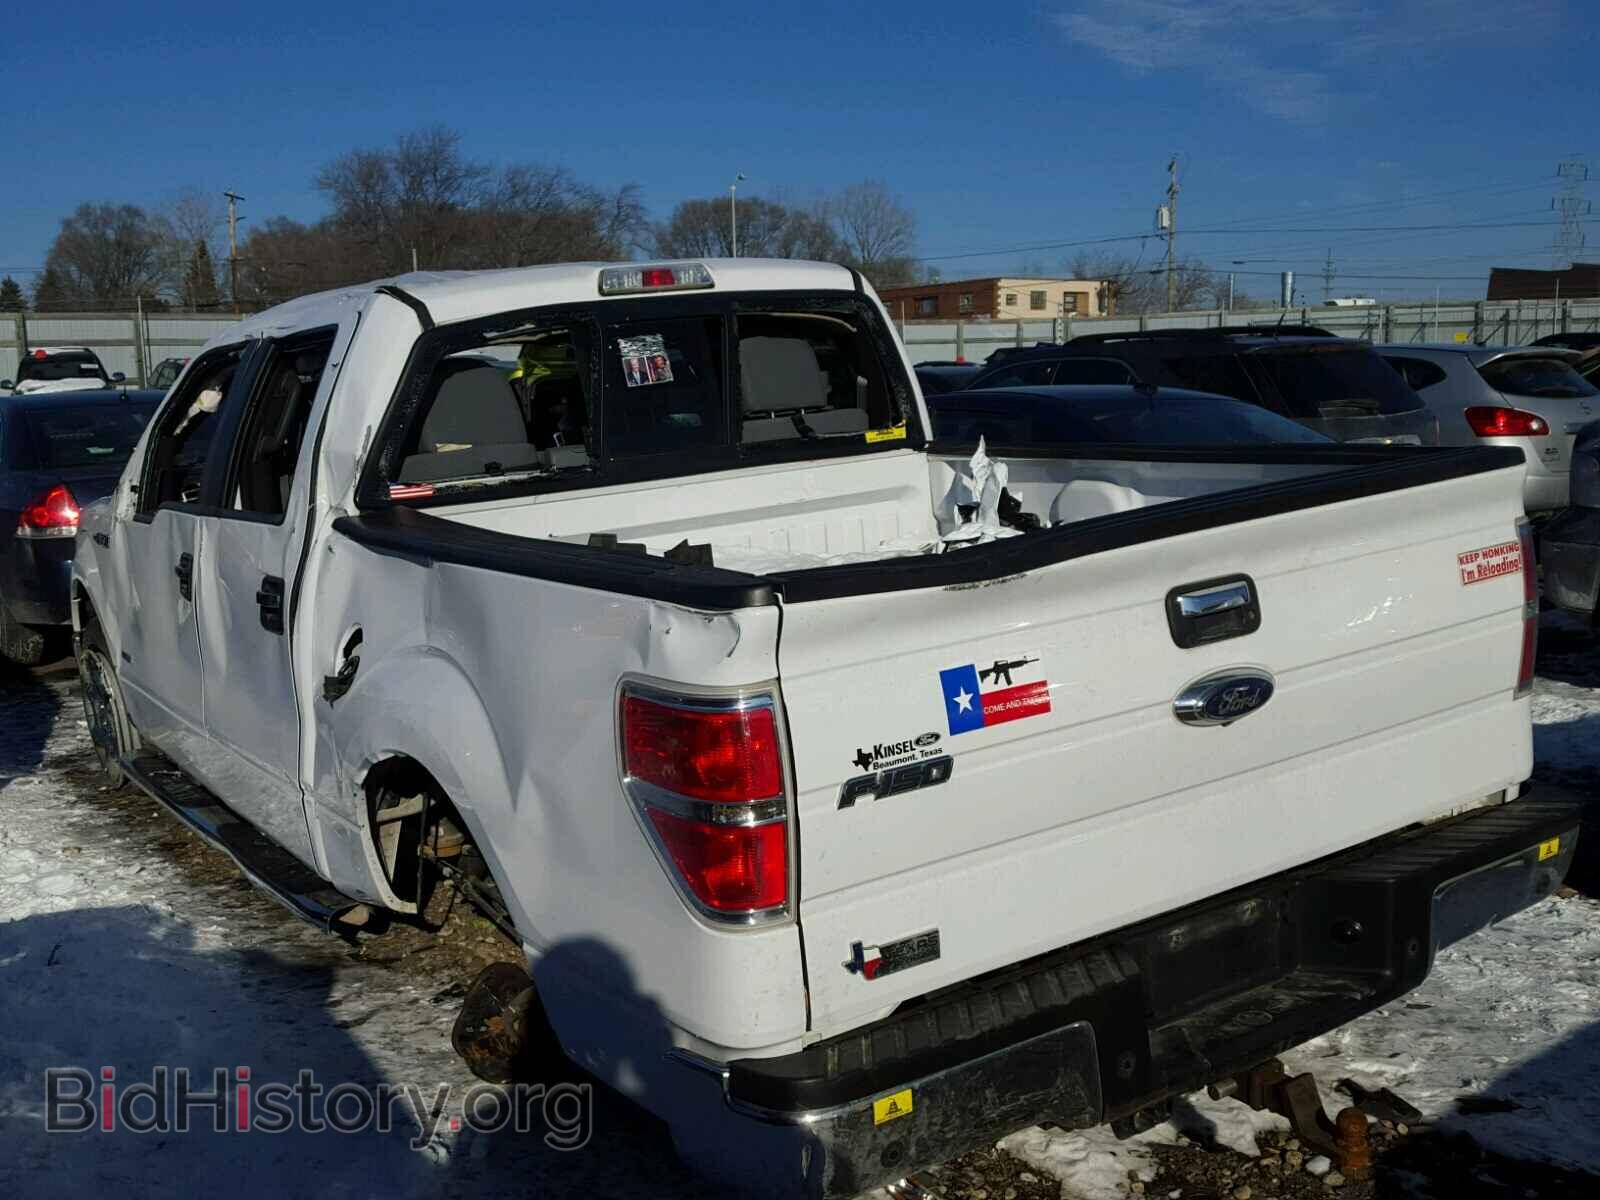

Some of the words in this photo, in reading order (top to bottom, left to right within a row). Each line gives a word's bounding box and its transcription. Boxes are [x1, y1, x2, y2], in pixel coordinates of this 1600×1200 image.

[1459, 553, 1480, 565] KEEP
[1482, 543, 1519, 560] HONKING
[983, 703, 1006, 714] COME
[1006, 700, 1020, 710] AND
[873, 740, 916, 760] KINSEL
[920, 748, 943, 758] Texas
